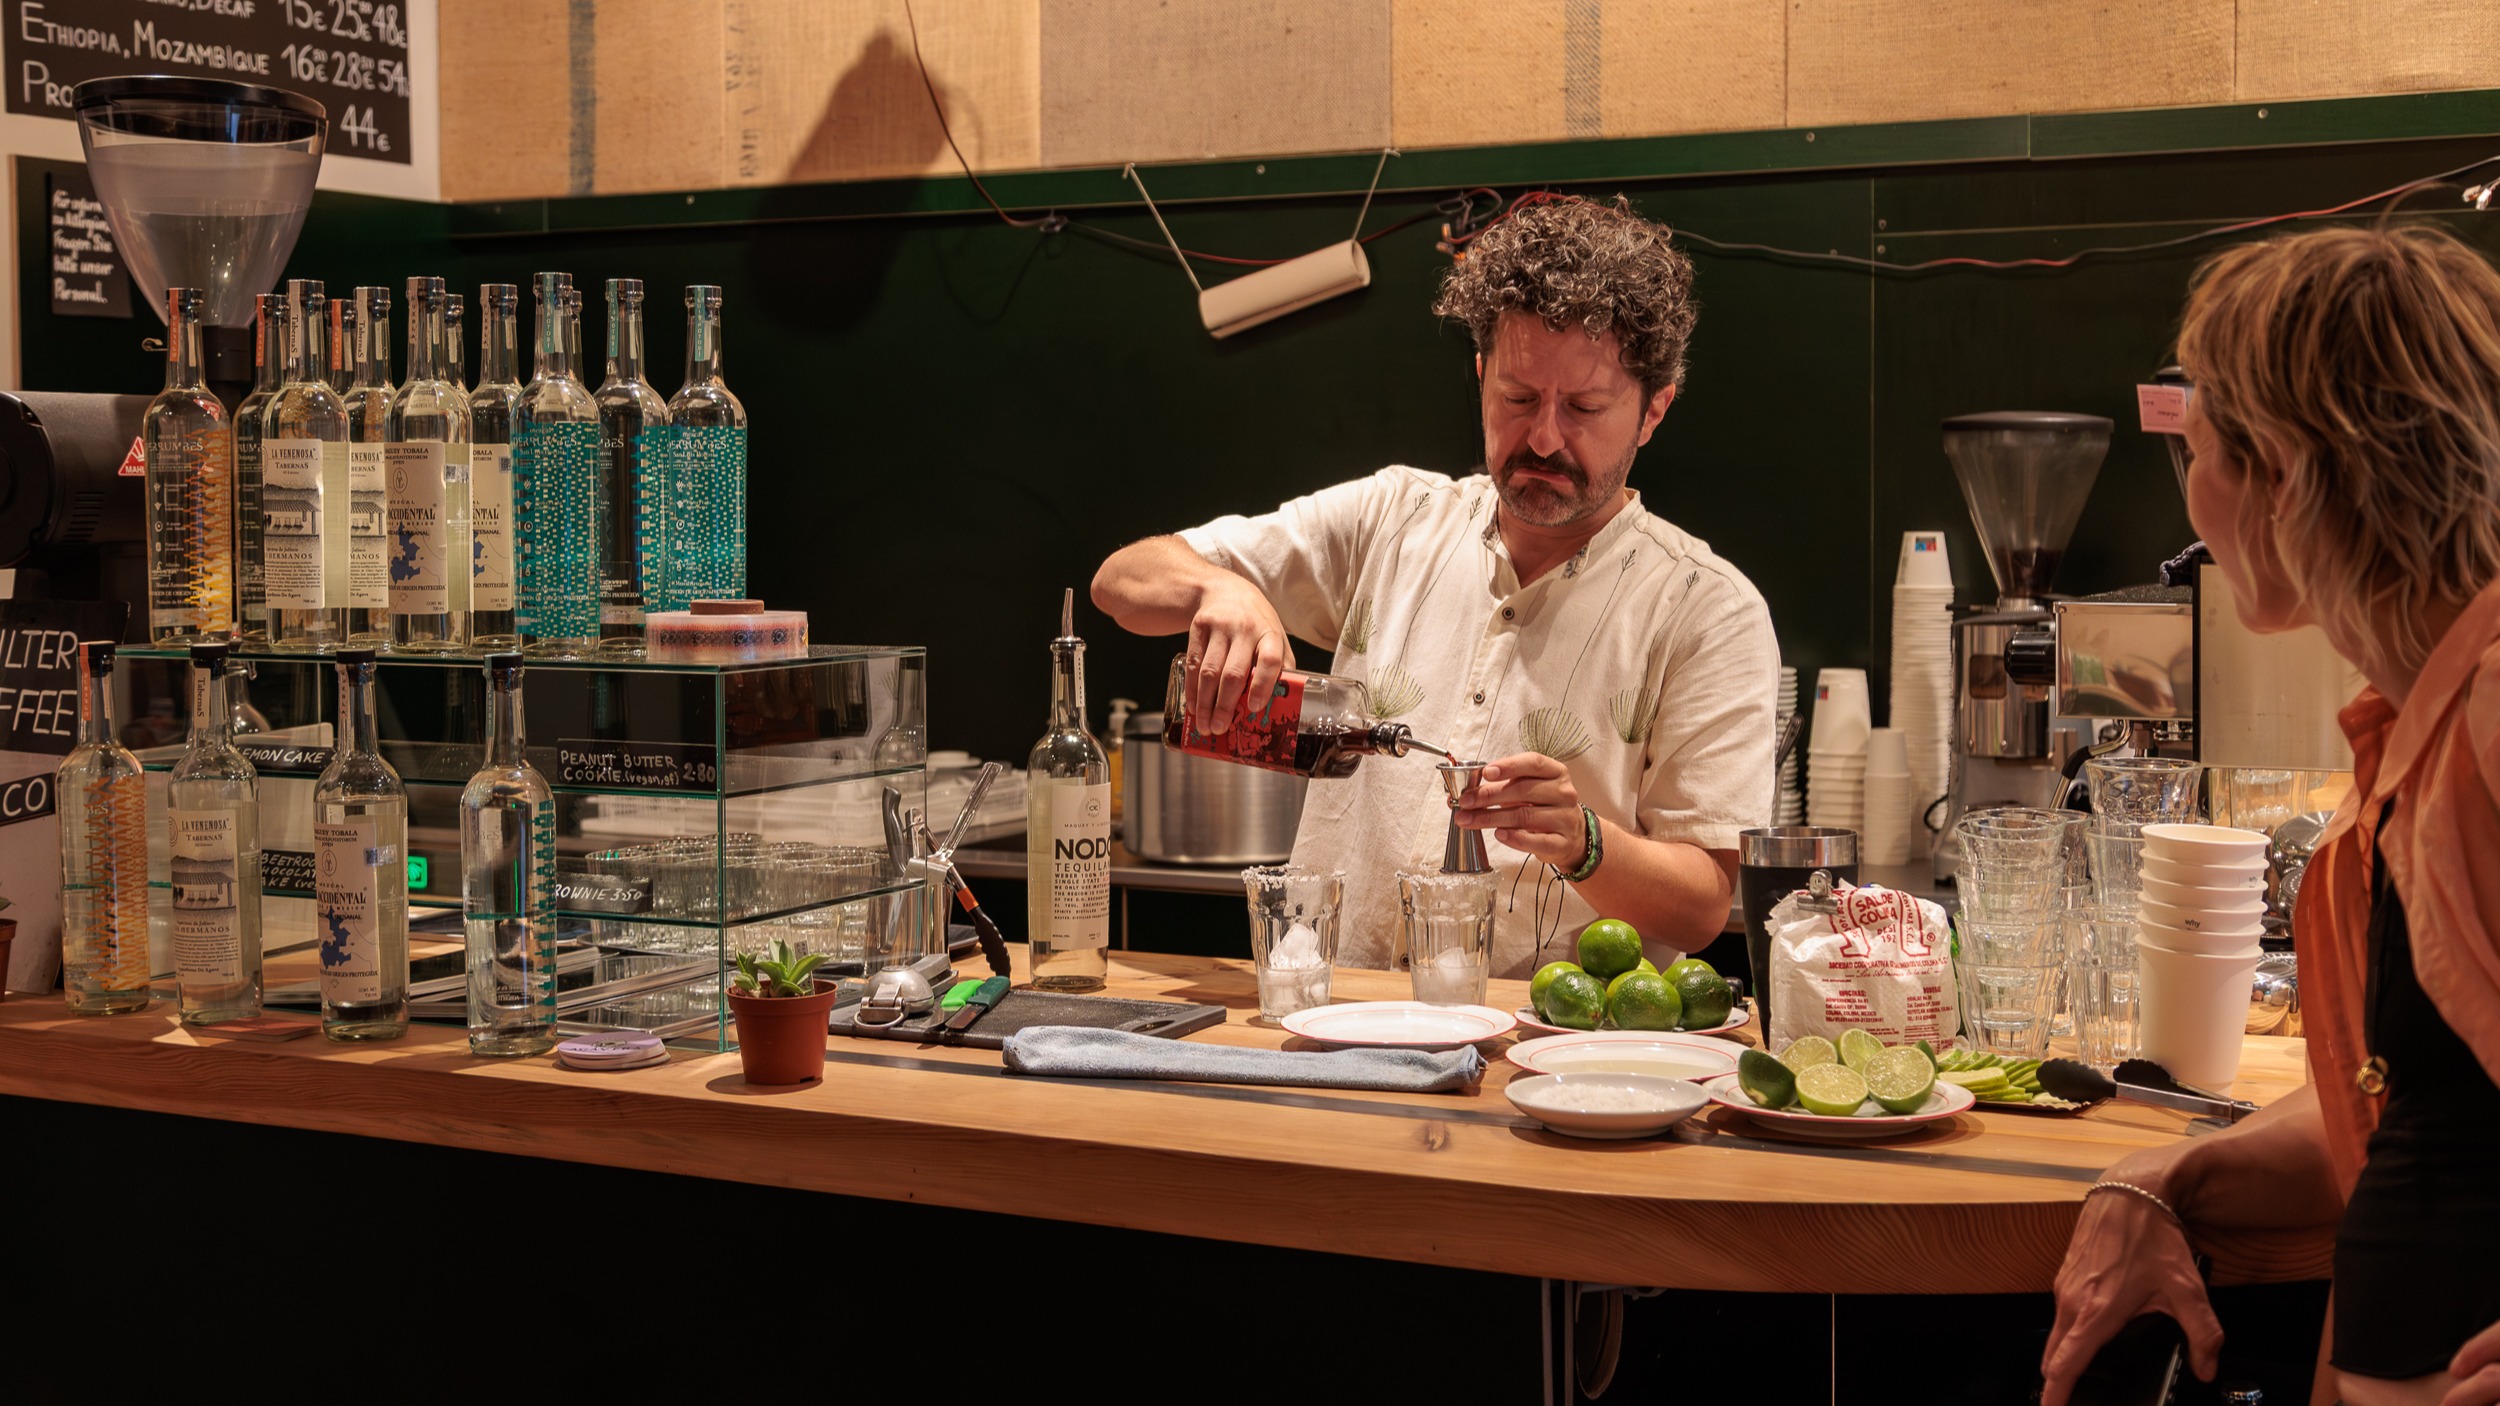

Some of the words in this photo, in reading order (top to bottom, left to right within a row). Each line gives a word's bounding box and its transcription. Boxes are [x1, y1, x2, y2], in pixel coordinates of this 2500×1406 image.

[280, 448, 313, 459] VENENOSA
[351, 452, 380, 462] ENENOSA
[473, 508, 499, 520] ENTAL
[242, 748, 282, 762] EMON
[283, 750, 326, 764] CAKE
[561, 750, 617, 767] PEANUT
[623, 753, 678, 769] BUTTER
[191, 819, 227, 831] VENENOSA
[1055, 835, 1110, 860] NOD
[261, 852, 316, 868] BEETROO
[262, 865, 316, 879] HOCOLAT
[1055, 861, 1110, 873] TEQUILA
[262, 876, 290, 888] AKE
[555, 884, 611, 900] ROWNIE
